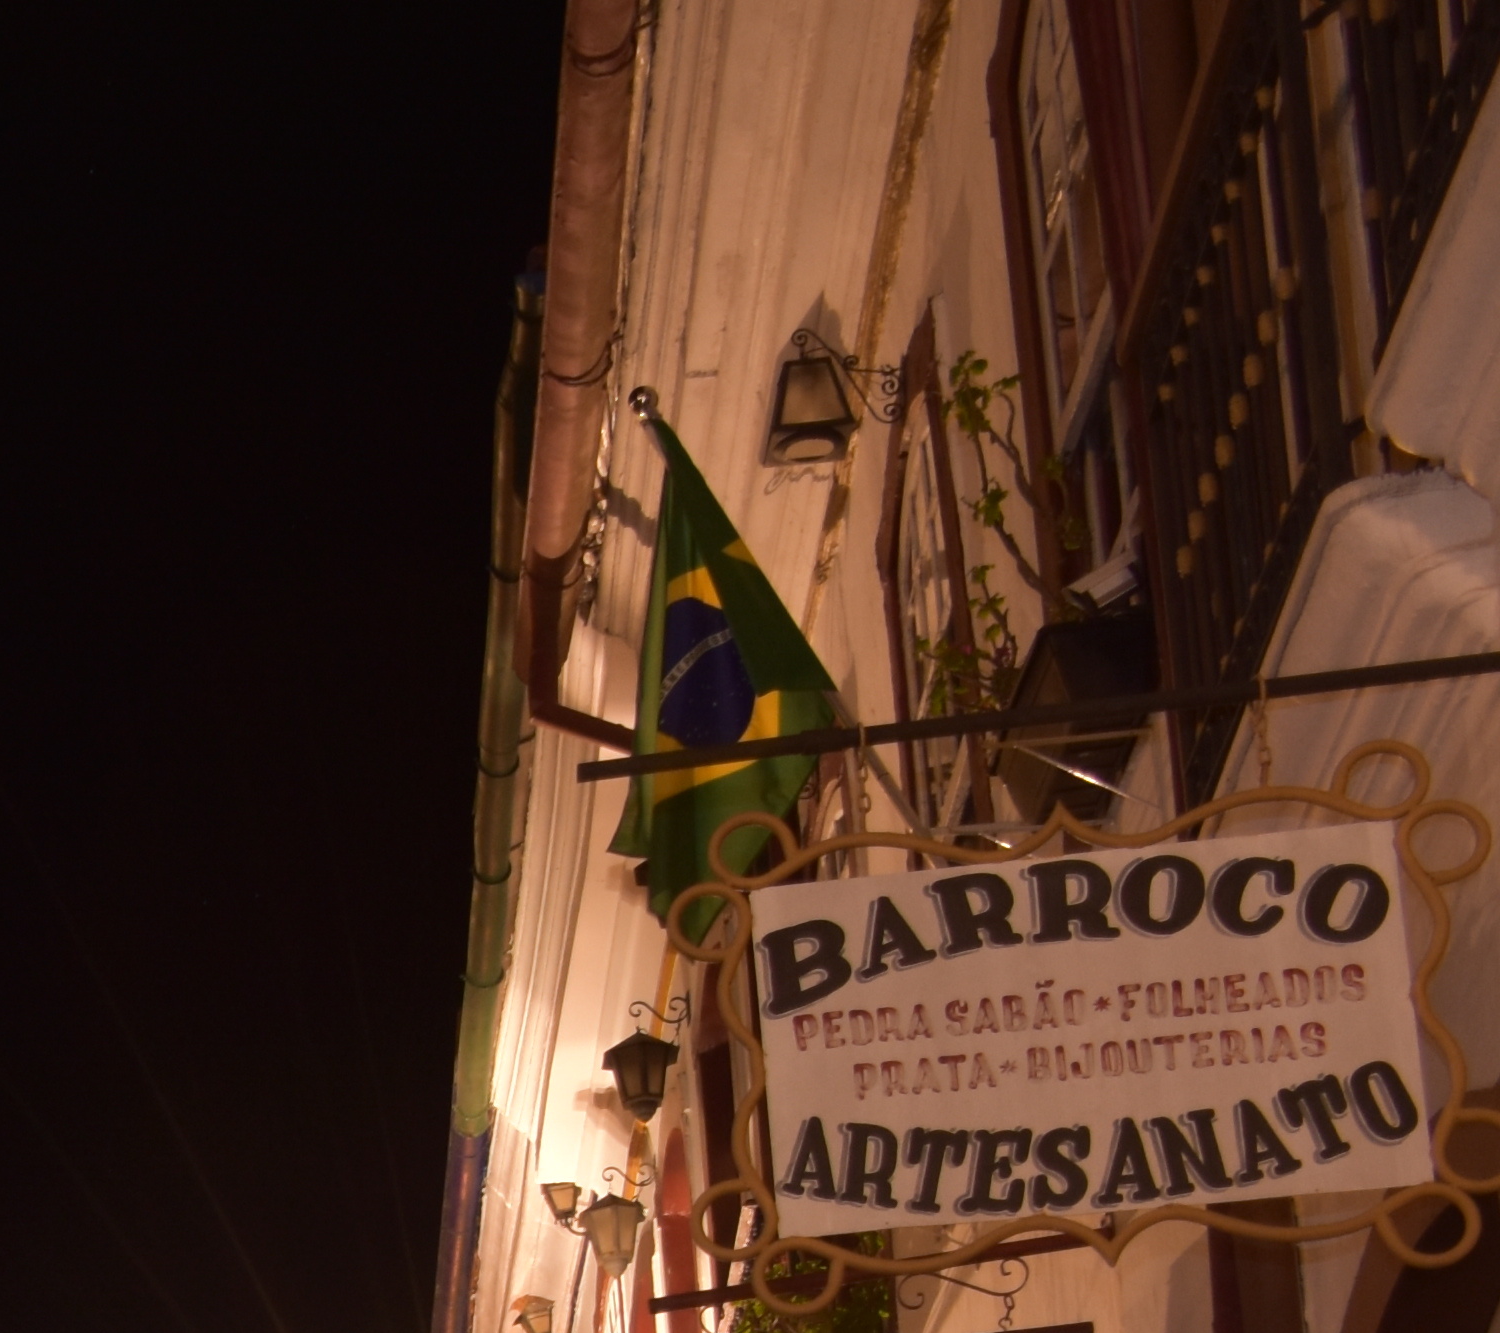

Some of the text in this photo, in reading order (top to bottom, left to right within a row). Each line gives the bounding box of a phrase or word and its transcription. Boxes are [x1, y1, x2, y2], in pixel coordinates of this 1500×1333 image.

[759, 854, 1391, 1019] BARROCO
[793, 963, 1367, 1052] PEDRA SABÃO FOLHEADOS
[852, 1021, 1328, 1101] PRATA BIJOUTERIAS
[775, 1059, 1420, 1217] ARTESANATO
